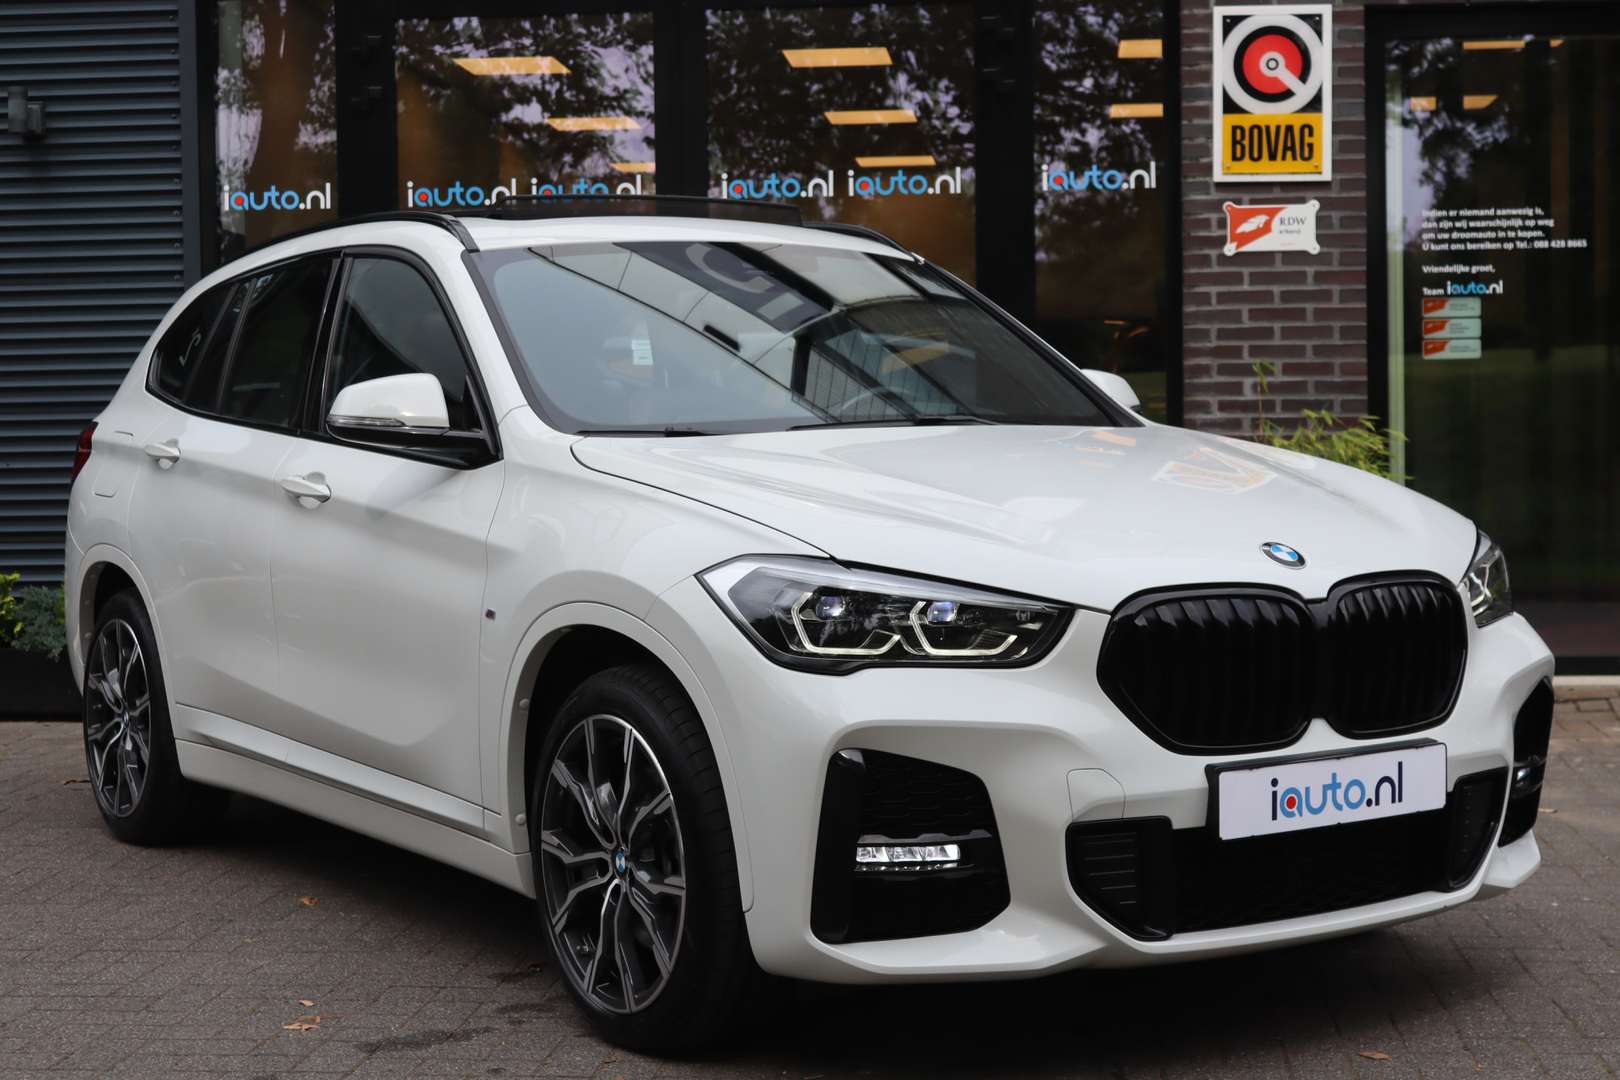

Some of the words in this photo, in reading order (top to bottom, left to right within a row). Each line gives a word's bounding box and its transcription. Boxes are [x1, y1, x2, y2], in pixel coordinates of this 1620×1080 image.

[1231, 124, 1314, 162] BOVAG
[531, 174, 642, 196] iautonl
[721, 169, 834, 200] iauto.nl
[847, 166, 961, 197] iauto.nl
[1041, 160, 1157, 191] iauto.nl
[223, 182, 331, 211] iauto.nl
[407, 178, 517, 208] iauto.nl
[1280, 216, 1307, 225] RDW
[1459, 208, 1495, 216] niemand
[1422, 220, 1437, 228] dan
[1454, 219, 1467, 229] wij
[1524, 219, 1536, 227] op
[1537, 219, 1554, 227] weg
[1451, 231, 1496, 239] droomauto
[1497, 230, 1506, 238] in
[1507, 230, 1516, 238] te
[1502, 242, 1514, 250] op
[1422, 265, 1470, 273] Vriendelijke
[1422, 287, 1445, 295] Team
[1446, 280, 1504, 295] iauto.nl
[1270, 761, 1403, 821] iauto.nl
